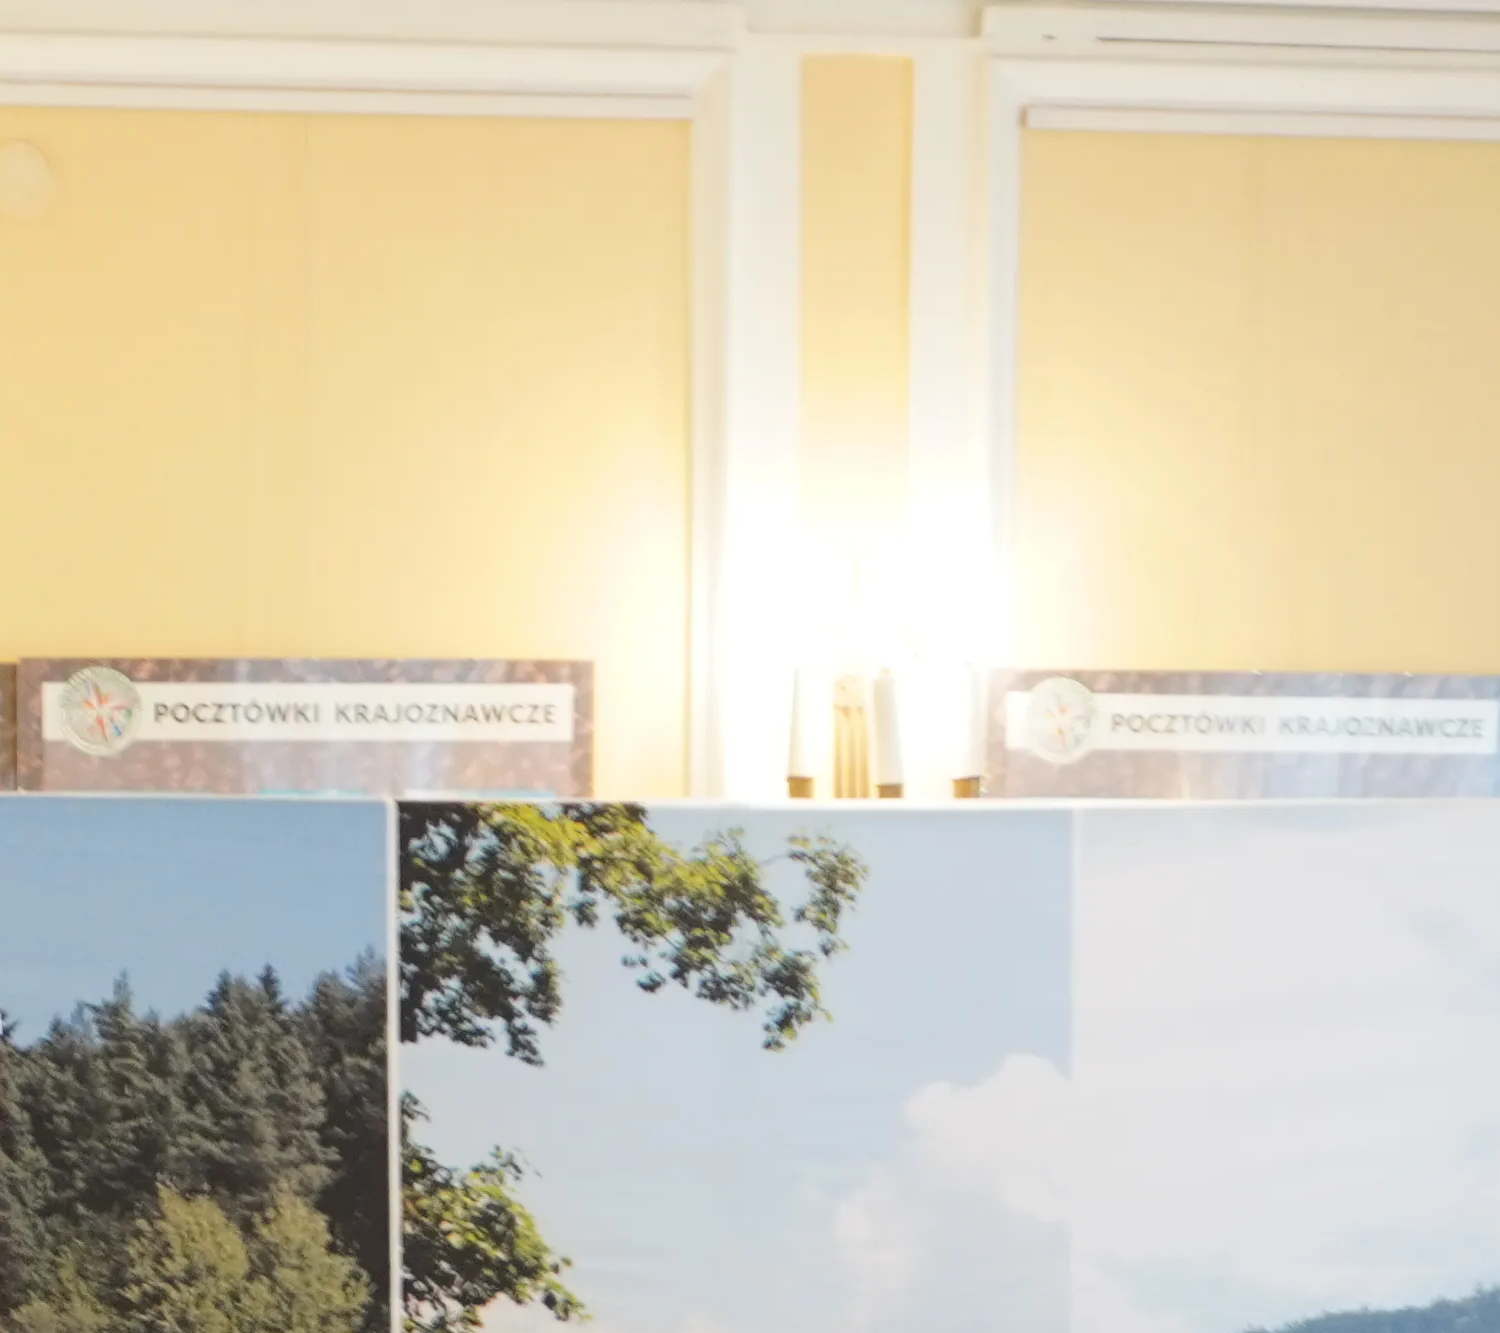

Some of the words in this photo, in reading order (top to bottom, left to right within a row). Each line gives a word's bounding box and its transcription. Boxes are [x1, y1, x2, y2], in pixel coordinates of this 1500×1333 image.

[154, 698, 321, 724] POCZTÓWKI
[335, 702, 558, 725] KRAJOZNAWCZE
[1279, 715, 1486, 739] KRAJOZNAWCZE
